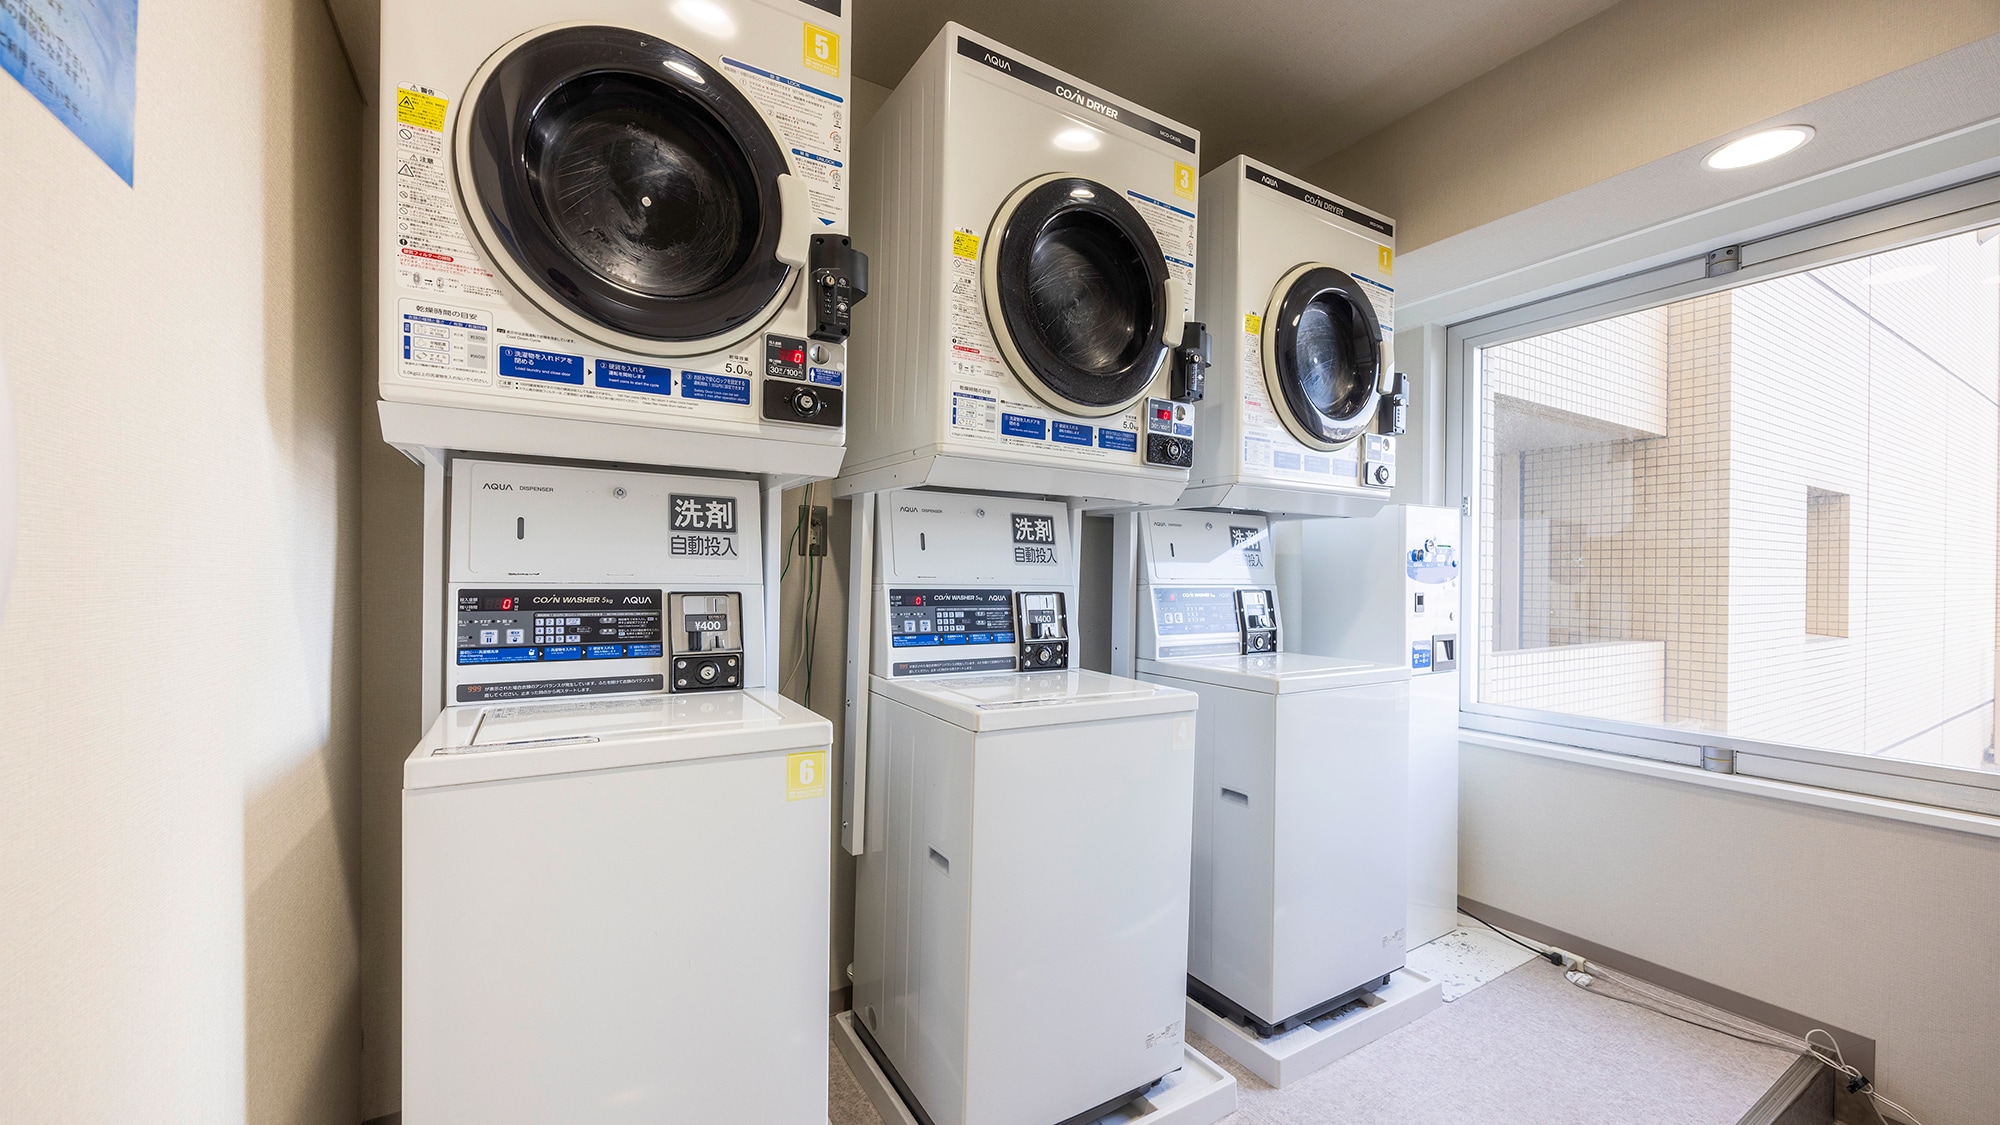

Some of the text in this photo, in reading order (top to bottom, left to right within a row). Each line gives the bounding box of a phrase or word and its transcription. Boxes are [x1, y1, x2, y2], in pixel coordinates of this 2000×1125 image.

[814, 33, 829, 60] 5
[984, 53, 1011, 72] AQUA
[1086, 98, 1119, 120] DRYER
[1181, 169, 1189, 189] 3
[1261, 175, 1279, 188] AQUA
[1323, 202, 1344, 217] DRYER
[1382, 251, 1388, 266] 1
[416, 305, 478, 321] 乾燥時間の目安
[793, 353, 802, 363] 0
[1163, 411, 1169, 420] 0
[483, 482, 514, 491] AQUA
[674, 498, 733, 530] 洗剤
[1014, 517, 1053, 542] 洗剤
[670, 534, 738, 557] 自動投入
[1014, 546, 1058, 564] 自動投入
[502, 598, 512, 610] 0
[562, 596, 601, 604] WASHER
[622, 596, 652, 604] AQUA
[915, 596, 921, 605] 0
[694, 621, 721, 631] ¥400
[1034, 615, 1051, 623] ¥400
[467, 685, 482, 693] 999
[800, 759, 815, 785] 6
